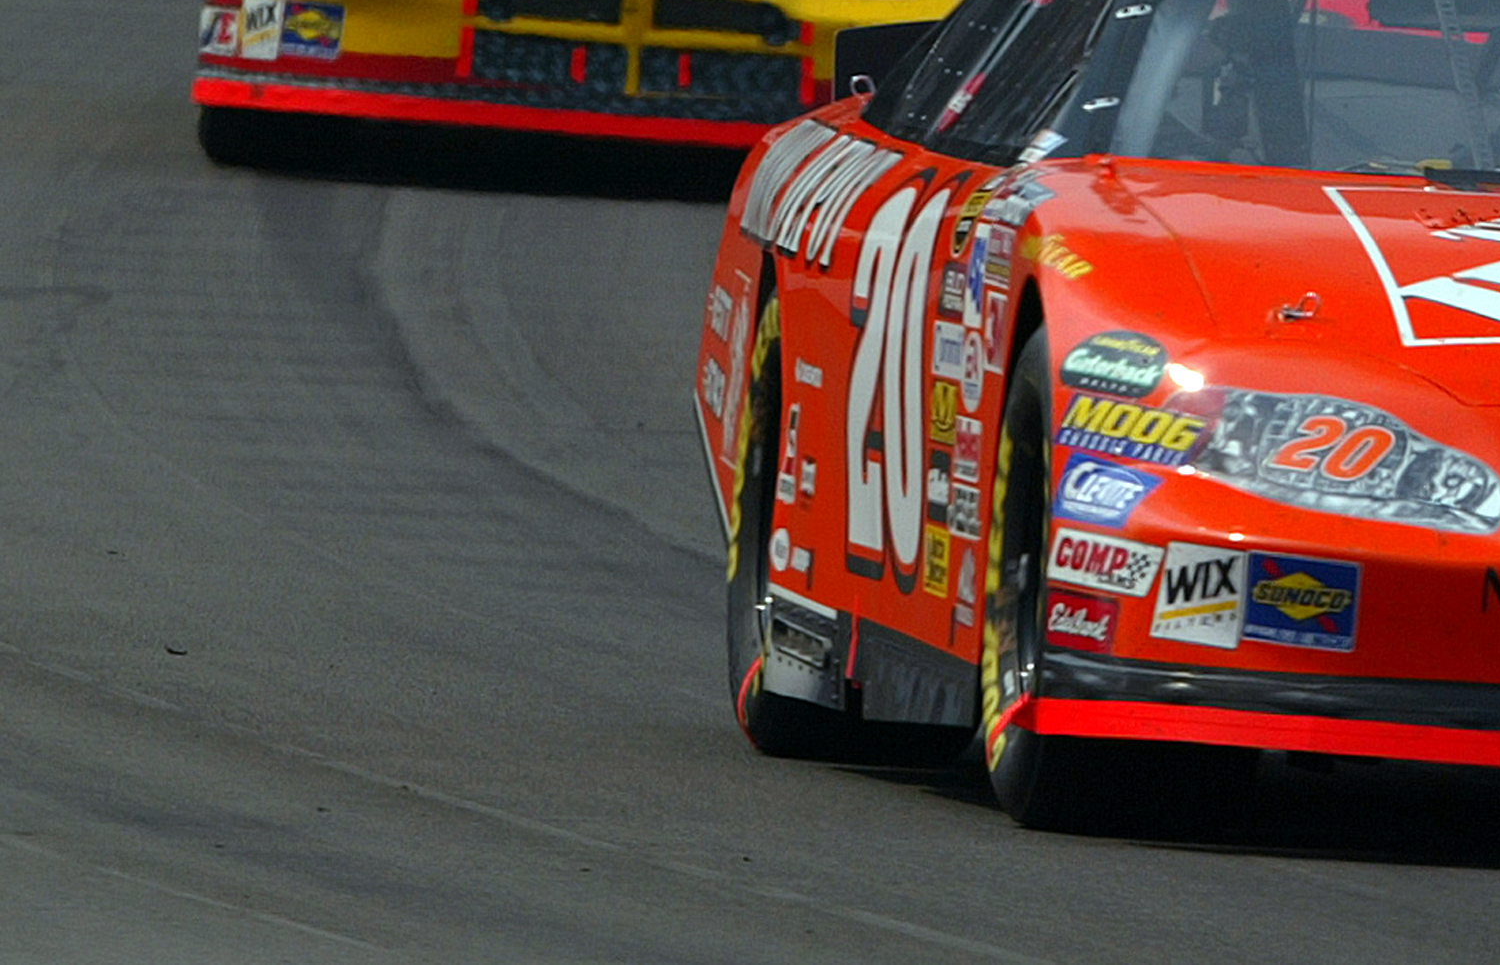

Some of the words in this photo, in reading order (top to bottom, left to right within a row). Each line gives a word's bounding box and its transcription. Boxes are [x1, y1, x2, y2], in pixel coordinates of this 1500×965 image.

[845, 180, 955, 580] 20
[1061, 396, 1208, 451] MOOG
[1266, 415, 1396, 481] 20
[1055, 538, 1130, 576] COMP
[1166, 555, 1242, 605] WIX
[1257, 583, 1347, 610] SUNOCO
